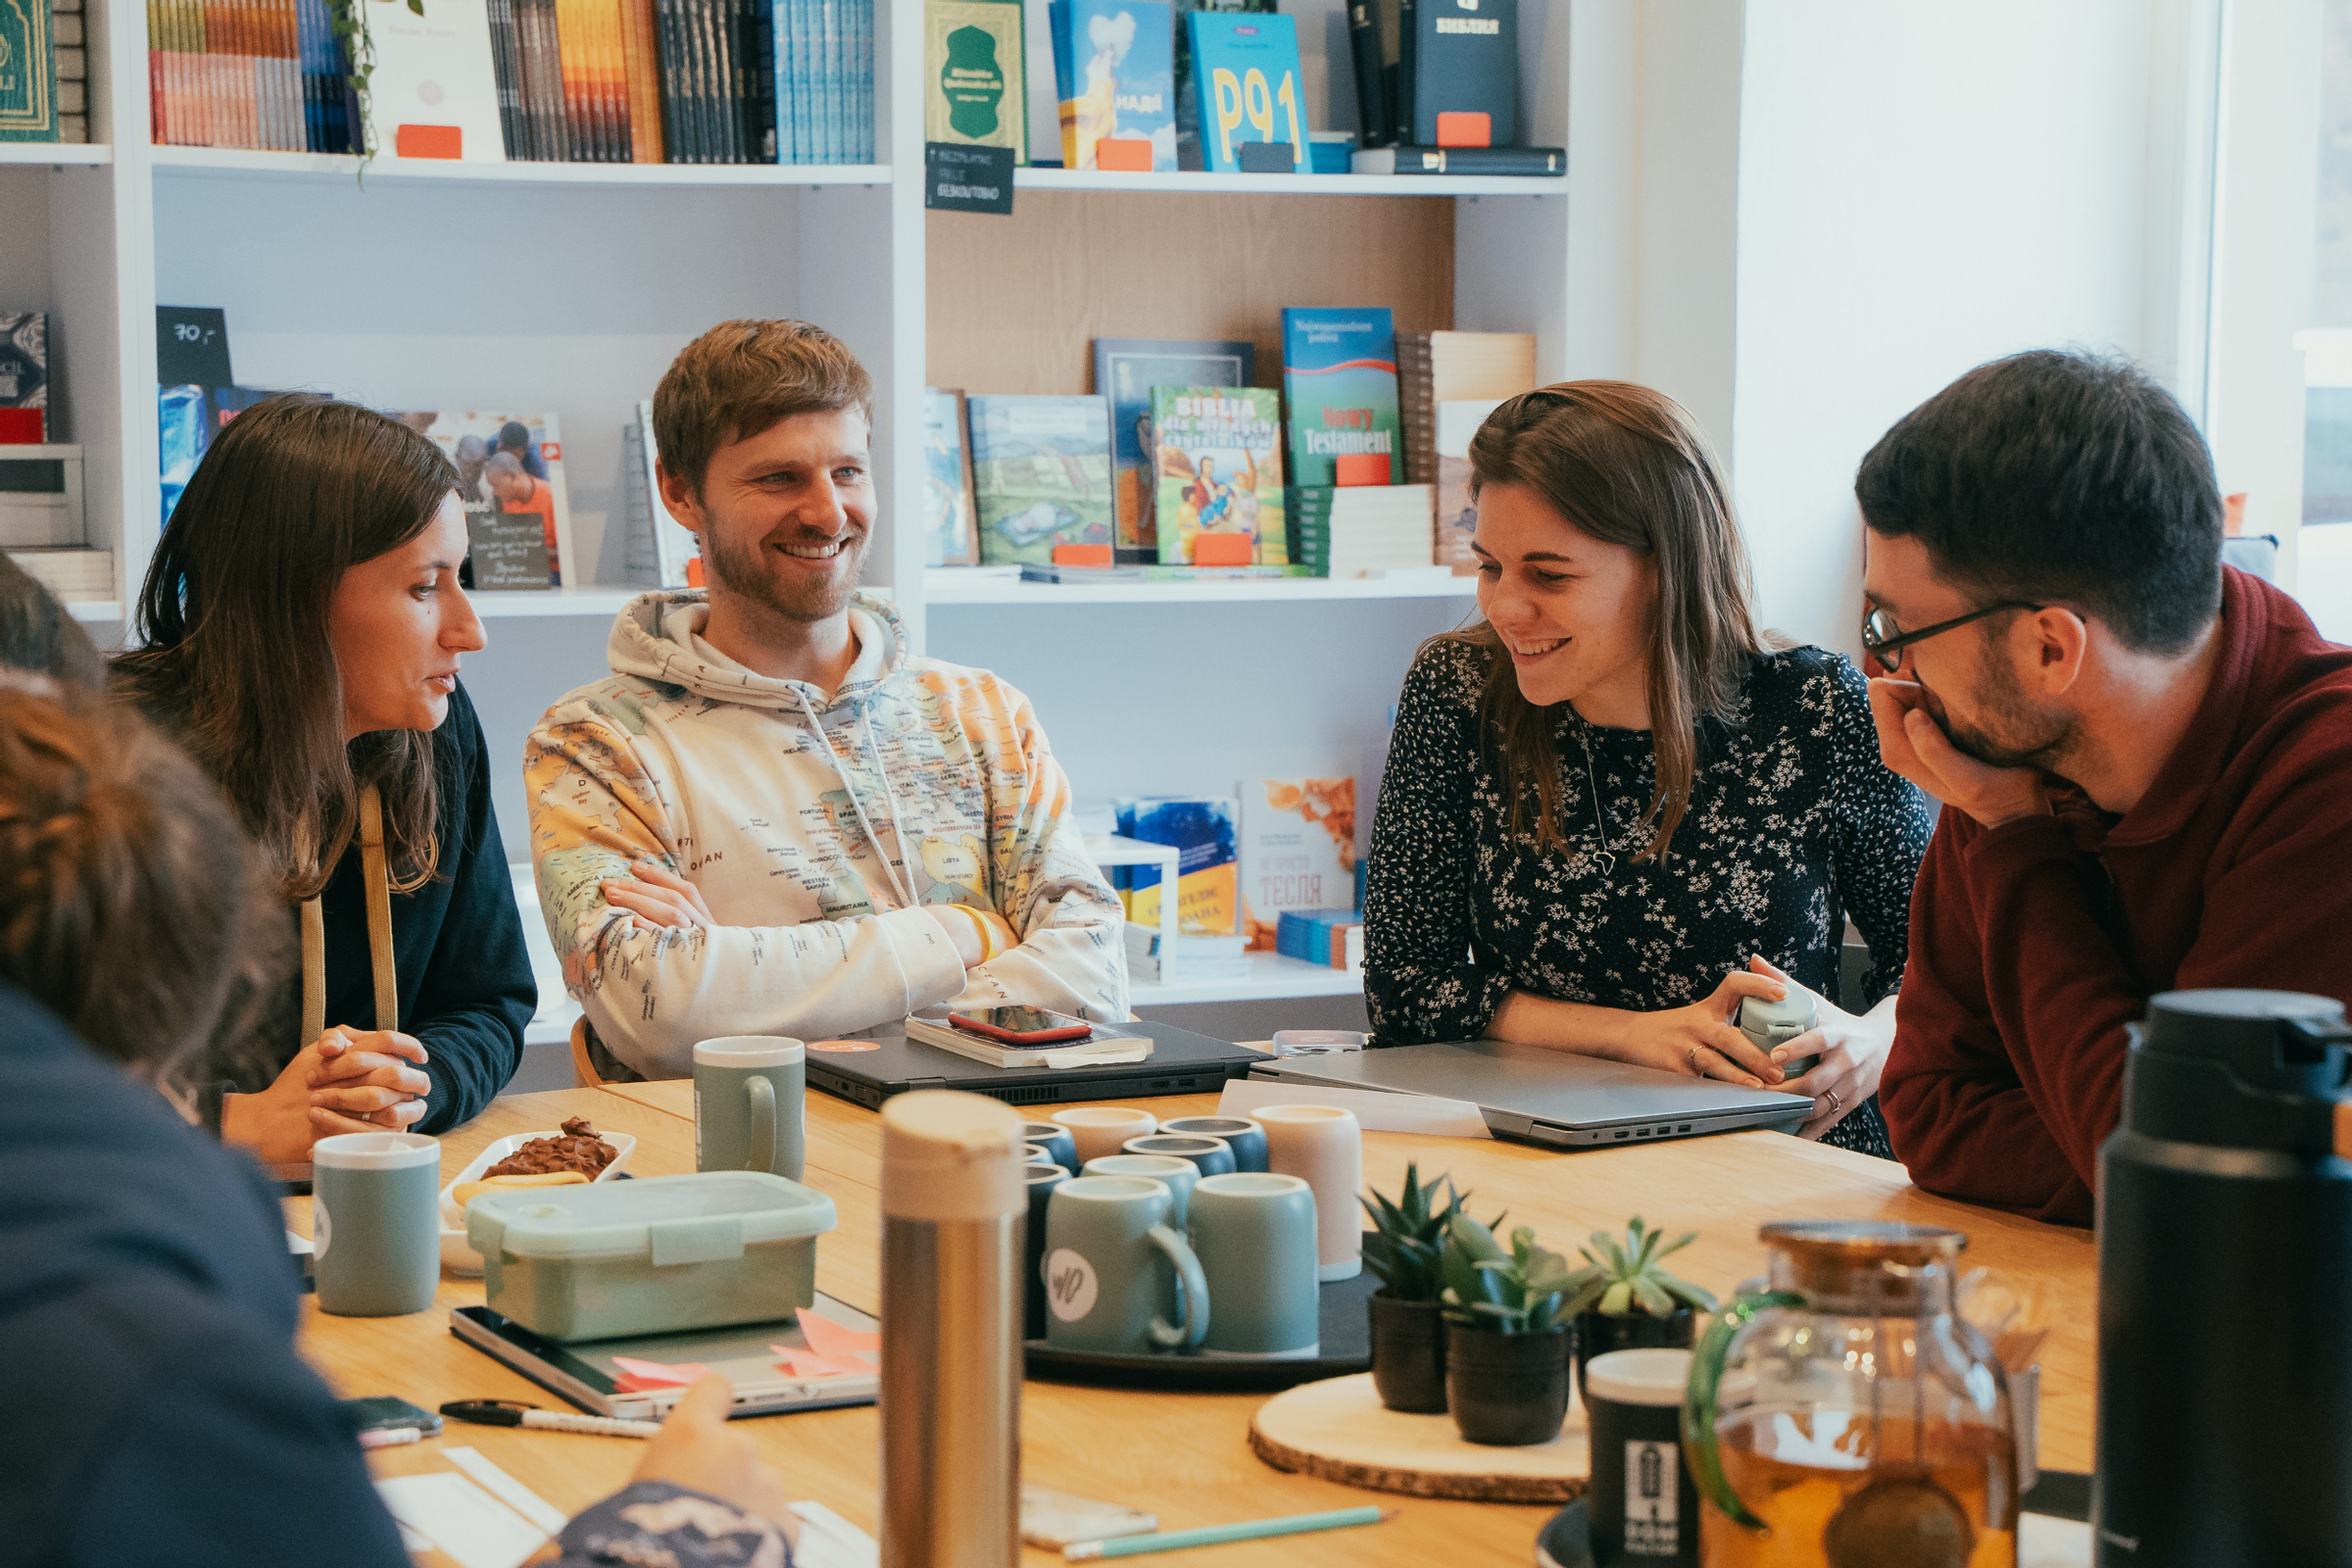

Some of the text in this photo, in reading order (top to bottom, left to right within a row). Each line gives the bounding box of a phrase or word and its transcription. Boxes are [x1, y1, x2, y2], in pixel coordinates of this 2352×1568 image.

[1436, 17, 1500, 35] БИБЛИЯ
[1175, 395, 1257, 418] BIBLIA
[1323, 406, 1373, 431] Nowy
[1303, 428, 1393, 455] Testament
[782, 745, 811, 755] IRELAND
[932, 824, 972, 833] MEDITERRANEAN
[808, 854, 842, 863] MOROCCO
[802, 876, 830, 885] WESTERN
[1259, 873, 1322, 906] ТЕСЛЯ
[825, 901, 869, 913] MAURITANIA
[978, 965, 1008, 999] CEAN
